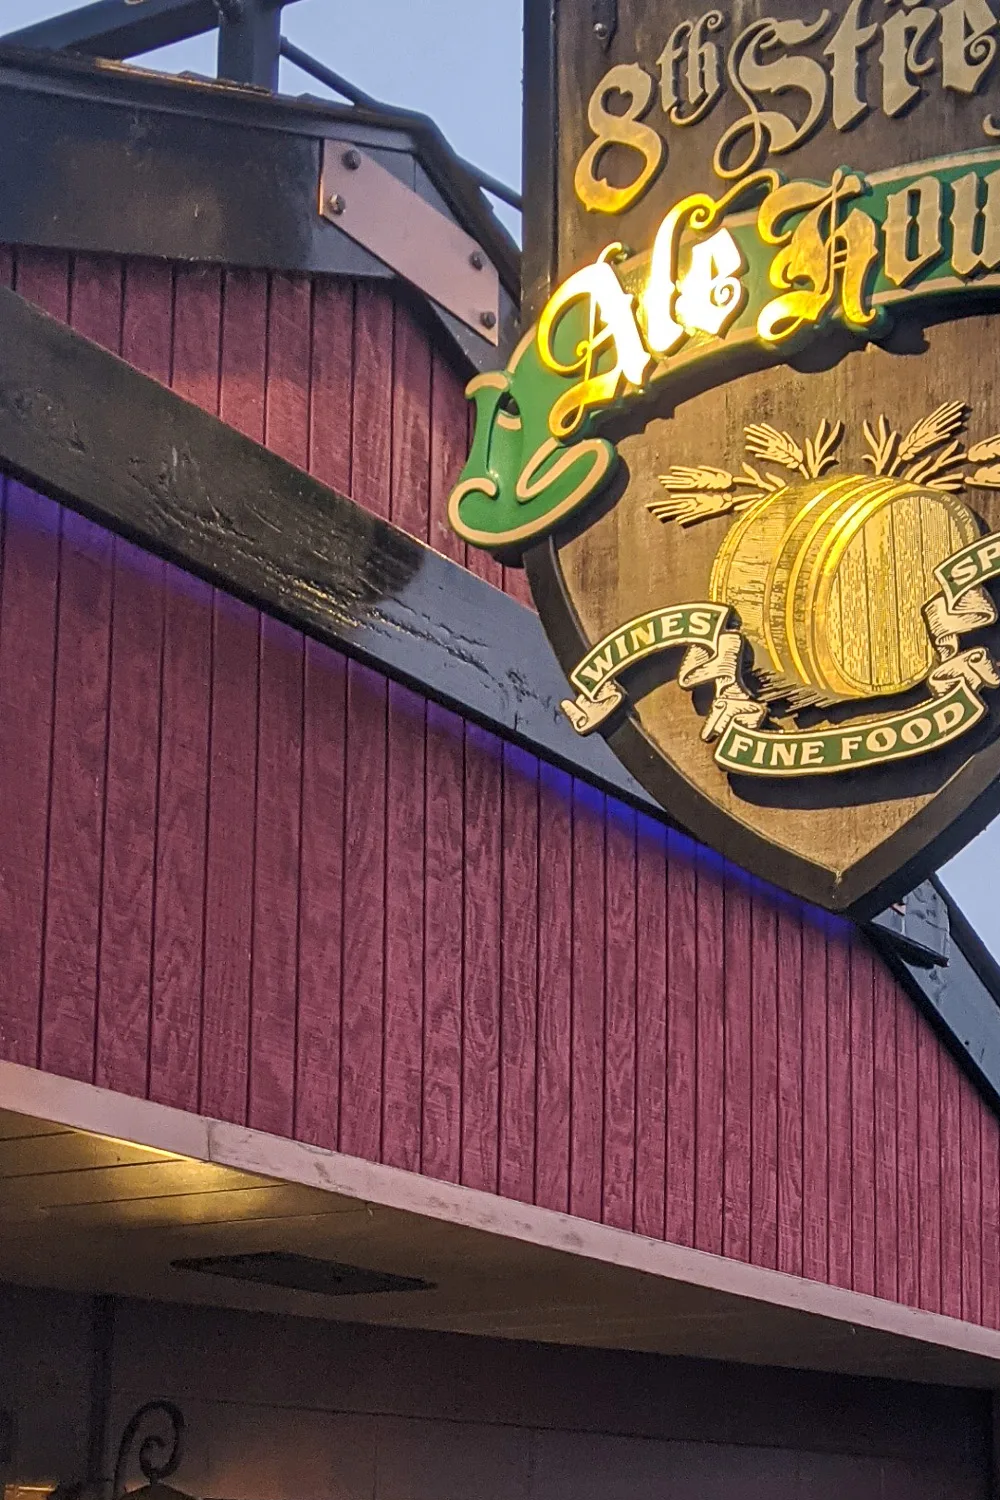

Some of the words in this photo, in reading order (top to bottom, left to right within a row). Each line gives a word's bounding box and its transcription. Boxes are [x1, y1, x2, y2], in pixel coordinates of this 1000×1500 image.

[573, 9, 724, 214] 8th
[537, 168, 779, 439] Ale
[583, 610, 714, 686] WINES
[727, 737, 825, 770] FINE
[840, 700, 968, 761] FOOD
